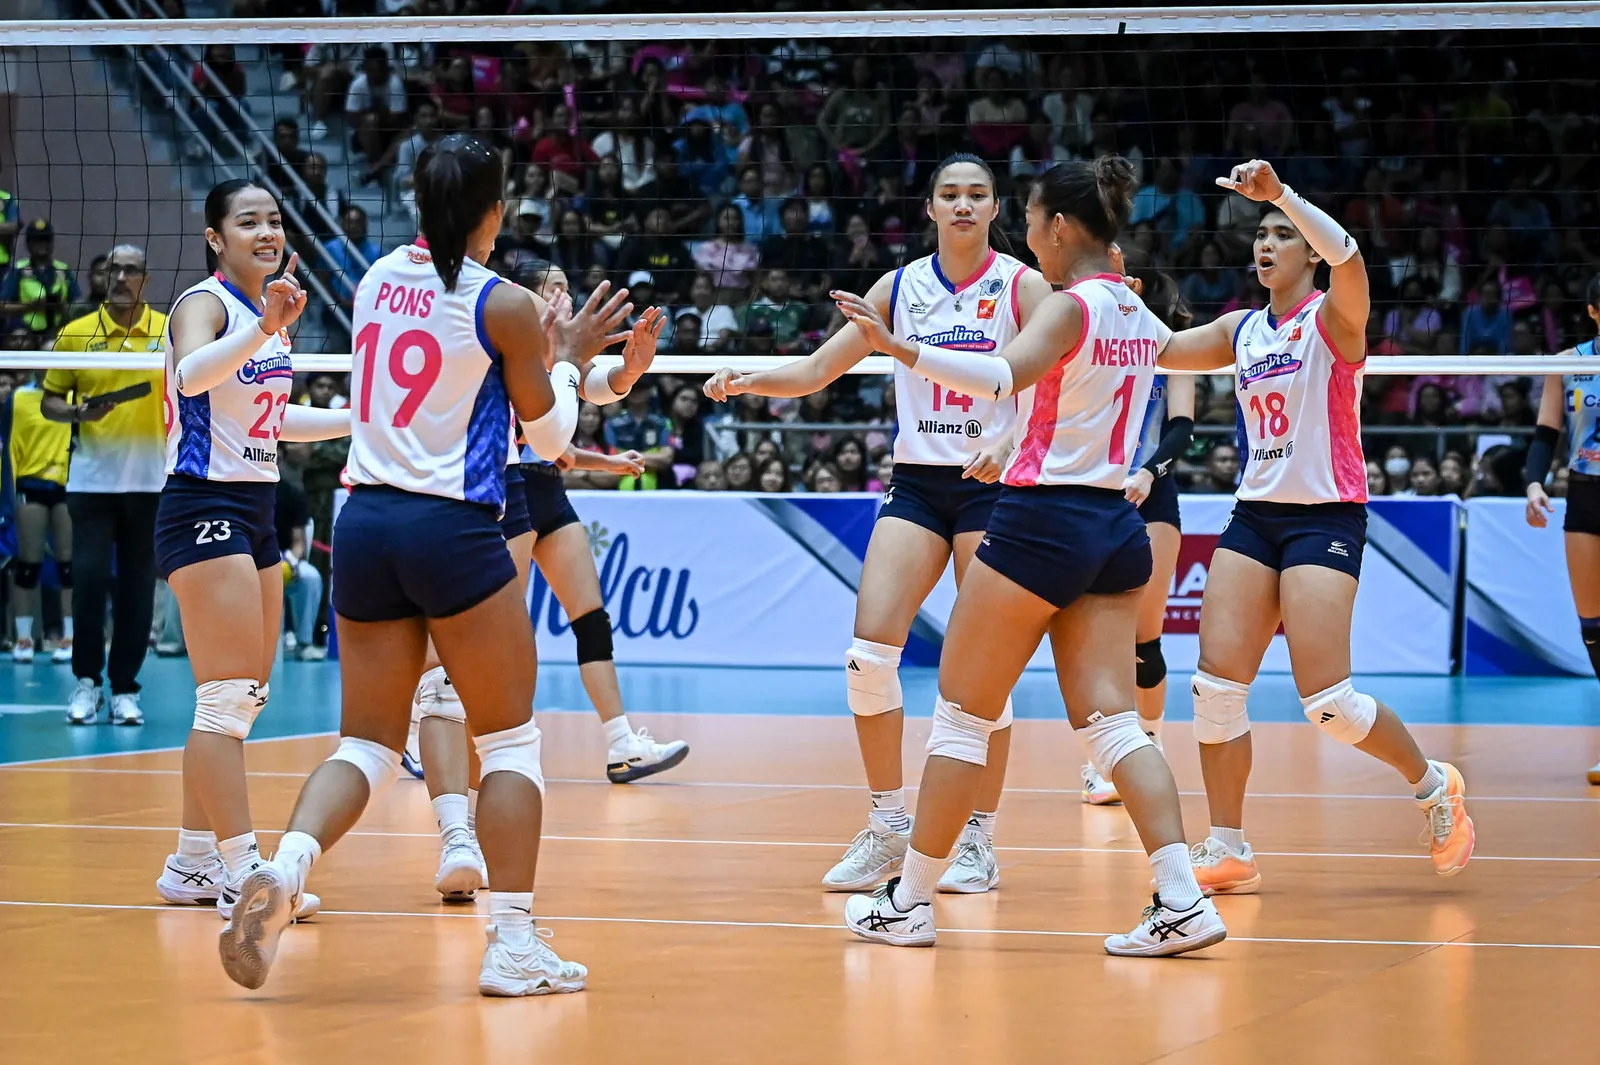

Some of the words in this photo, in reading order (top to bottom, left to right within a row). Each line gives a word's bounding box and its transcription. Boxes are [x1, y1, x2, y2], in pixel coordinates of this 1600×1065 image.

[375, 282, 435, 318] PONS
[355, 322, 443, 428] 19
[917, 420, 962, 434] Allianz
[1108, 375, 1137, 465] 1
[1249, 392, 1290, 440] 18
[194, 520, 231, 545] 23
